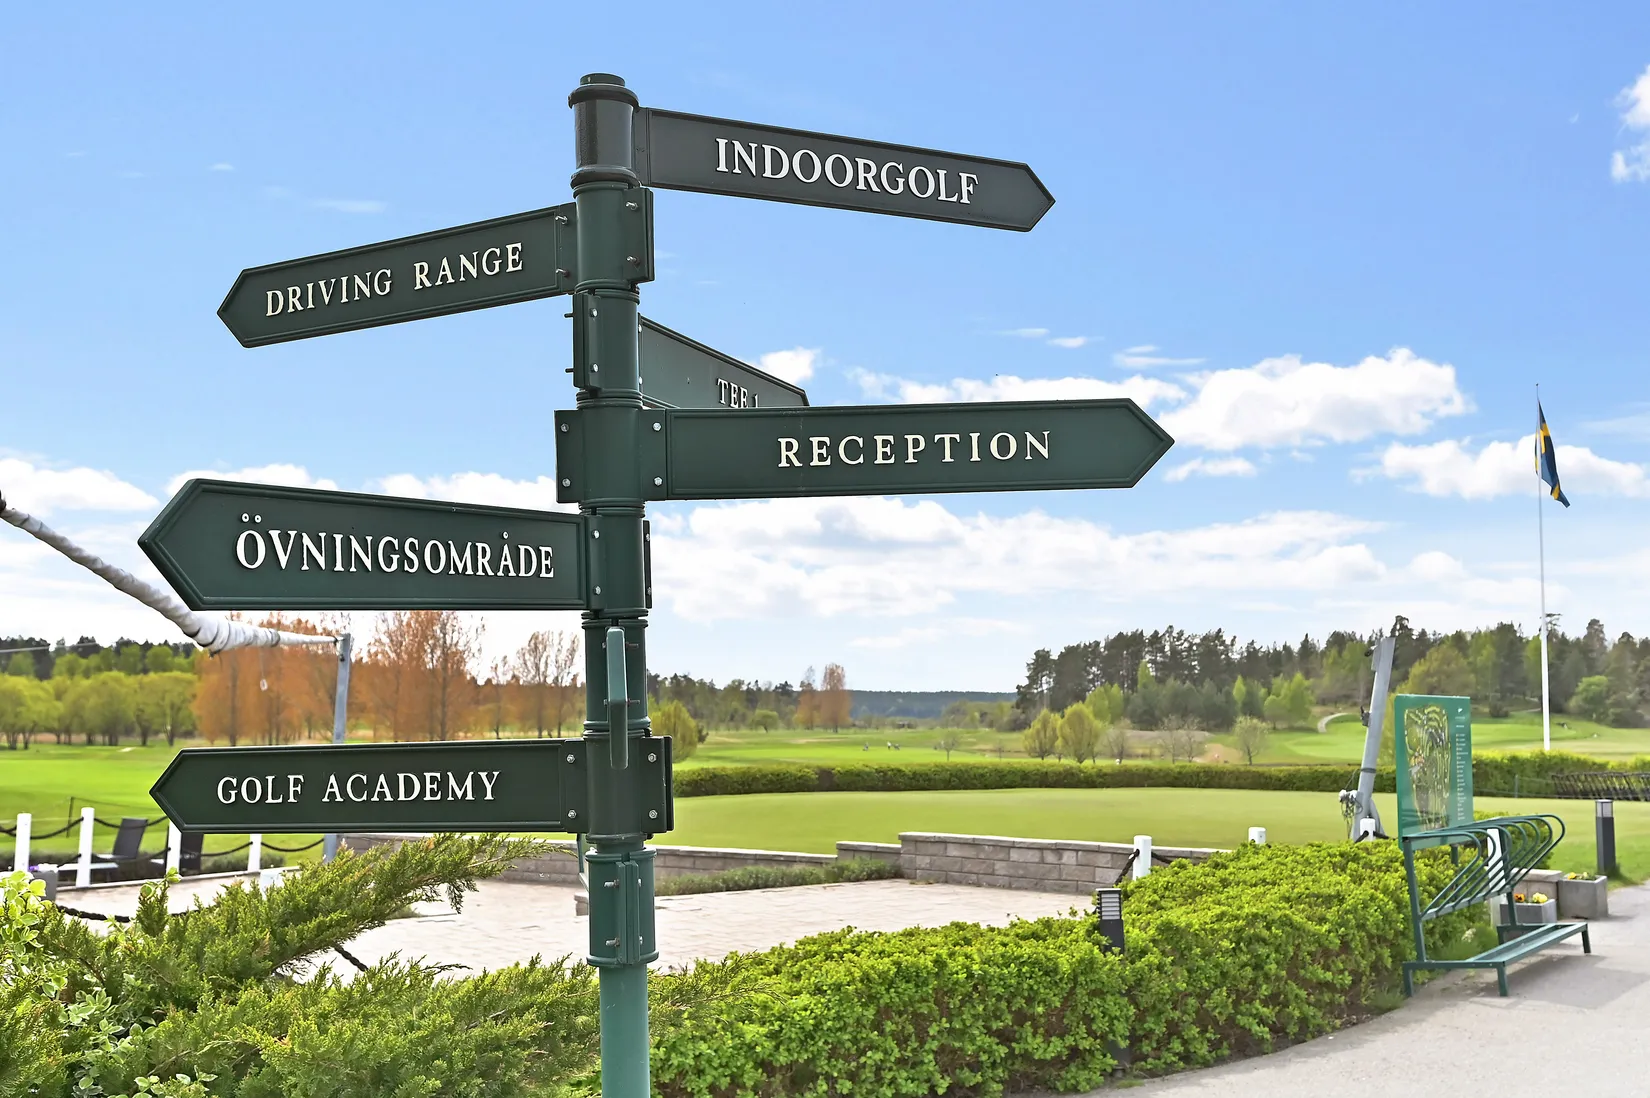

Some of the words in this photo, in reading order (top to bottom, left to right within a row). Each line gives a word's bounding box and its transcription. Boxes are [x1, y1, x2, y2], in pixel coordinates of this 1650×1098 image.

[715, 137, 979, 204] INDOORGOLF
[265, 268, 392, 317] DRIVING
[413, 242, 523, 291] RANGE
[717, 378, 749, 409] TEE
[777, 430, 1051, 468] RECEPTION
[236, 512, 554, 578] ÖVNINGSOMRÅDE
[217, 774, 305, 804] GOLF
[321, 771, 500, 802] ACADEMY
